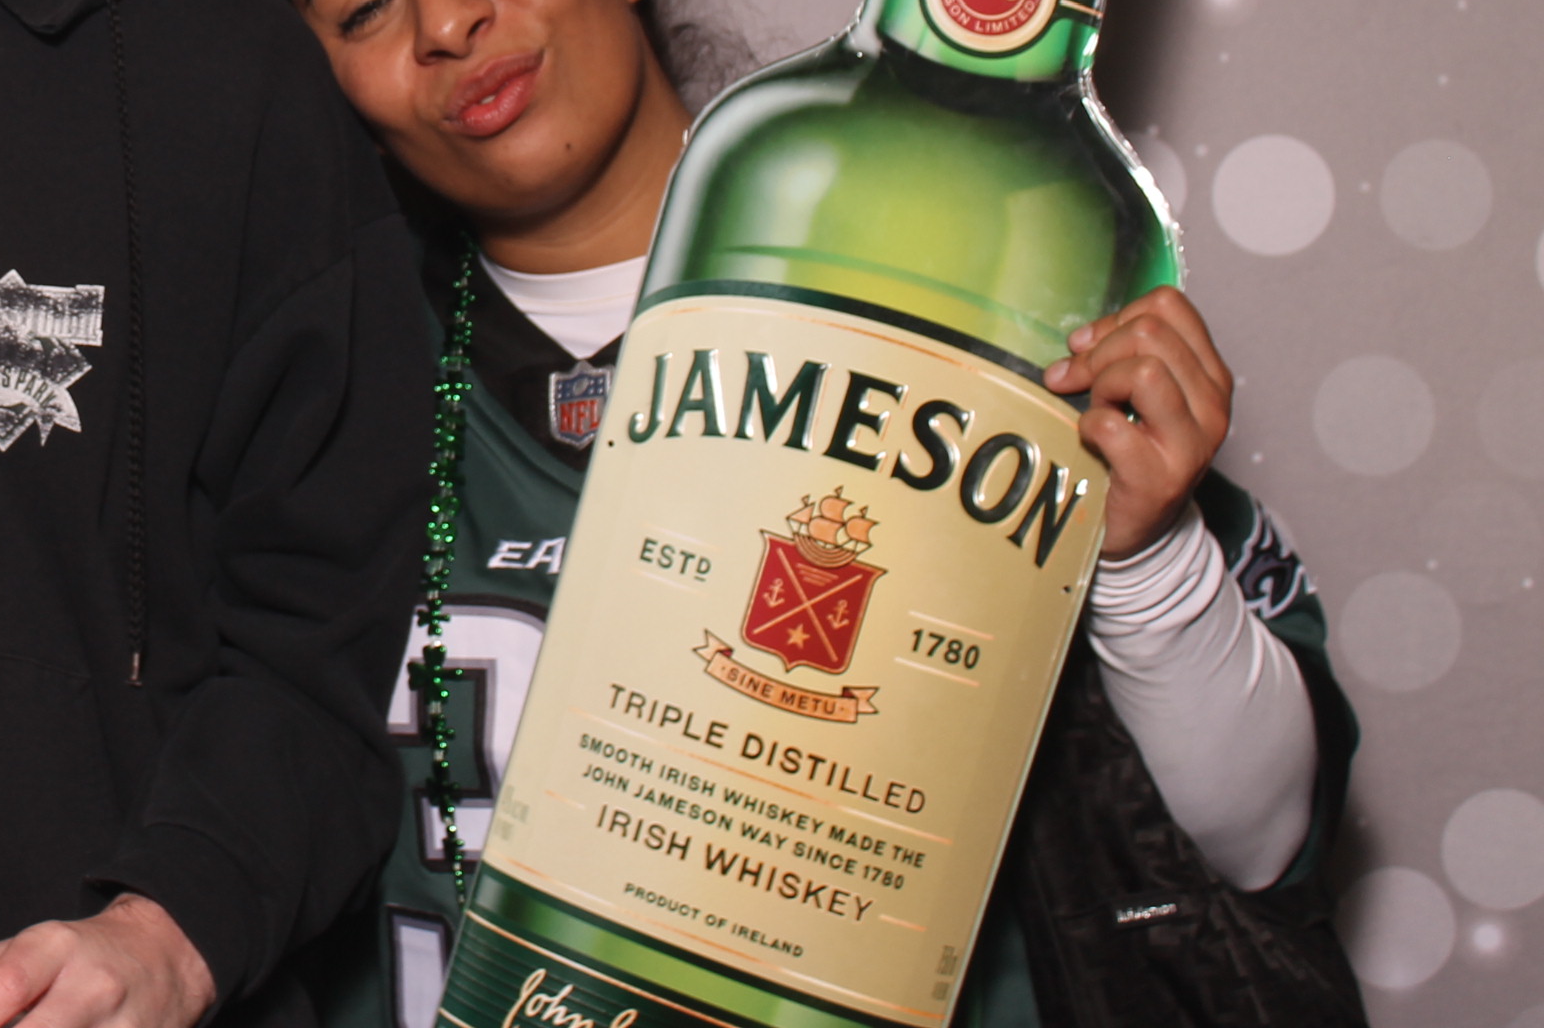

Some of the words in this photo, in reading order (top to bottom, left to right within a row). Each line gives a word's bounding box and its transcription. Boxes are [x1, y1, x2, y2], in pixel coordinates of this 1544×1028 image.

[975, 0, 1036, 33] LIMITED
[14, 367, 58, 408] PARK
[559, 399, 600, 436] NFL
[628, 349, 1088, 569] JAMESON
[908, 629, 981, 671] 1780
[724, 666, 774, 699] SINE
[781, 689, 837, 716] METU
[608, 683, 729, 749] TRIPLE
[740, 733, 926, 815] DISTILLED
[578, 733, 654, 773] SMOOTH
[658, 764, 716, 797] IRISH
[723, 788, 824, 833] WHISKEY
[828, 825, 887, 856] MADE
[892, 845, 927, 869] THE
[582, 763, 630, 792] JOHN
[633, 784, 734, 833] JAMESON
[740, 822, 788, 851] WAY
[792, 842, 857, 875] SINCE
[862, 864, 905, 891] 1780
[596, 804, 692, 861] IRISH
[704, 843, 874, 922] WHISKEY
[624, 882, 701, 920] PRODUCT
[705, 913, 727, 931] OF
[731, 923, 804, 959] IRELAND
